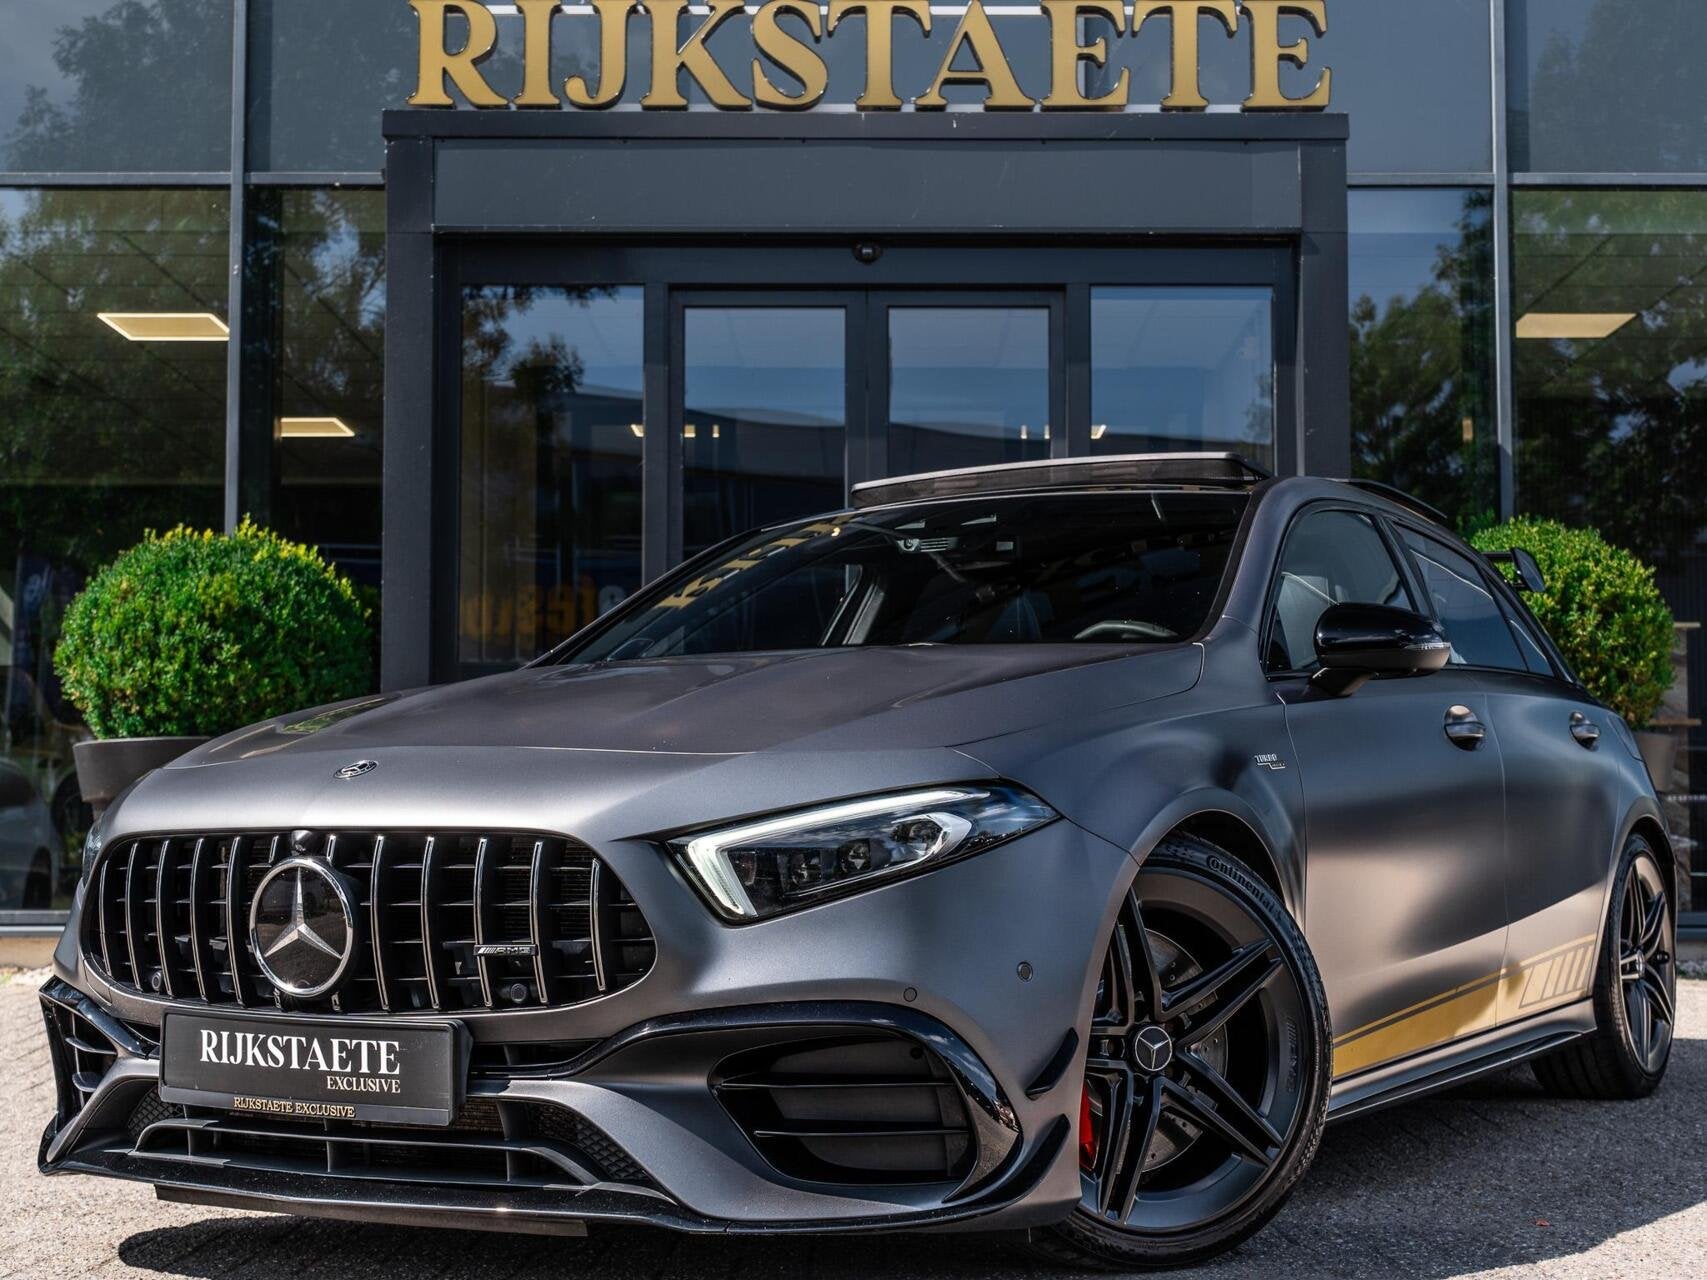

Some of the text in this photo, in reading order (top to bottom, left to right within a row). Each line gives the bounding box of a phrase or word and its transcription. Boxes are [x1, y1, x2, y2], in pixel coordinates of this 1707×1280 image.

[407, 0, 1331, 110] RIJKSTAETE
[1207, 855, 1276, 913] Continental
[200, 1029, 400, 1074] RIJKSTAETE
[327, 1075, 400, 1093] EXCLUSIVE
[233, 1096, 355, 1118] RIJKSTAETE EXCLUSIVE
